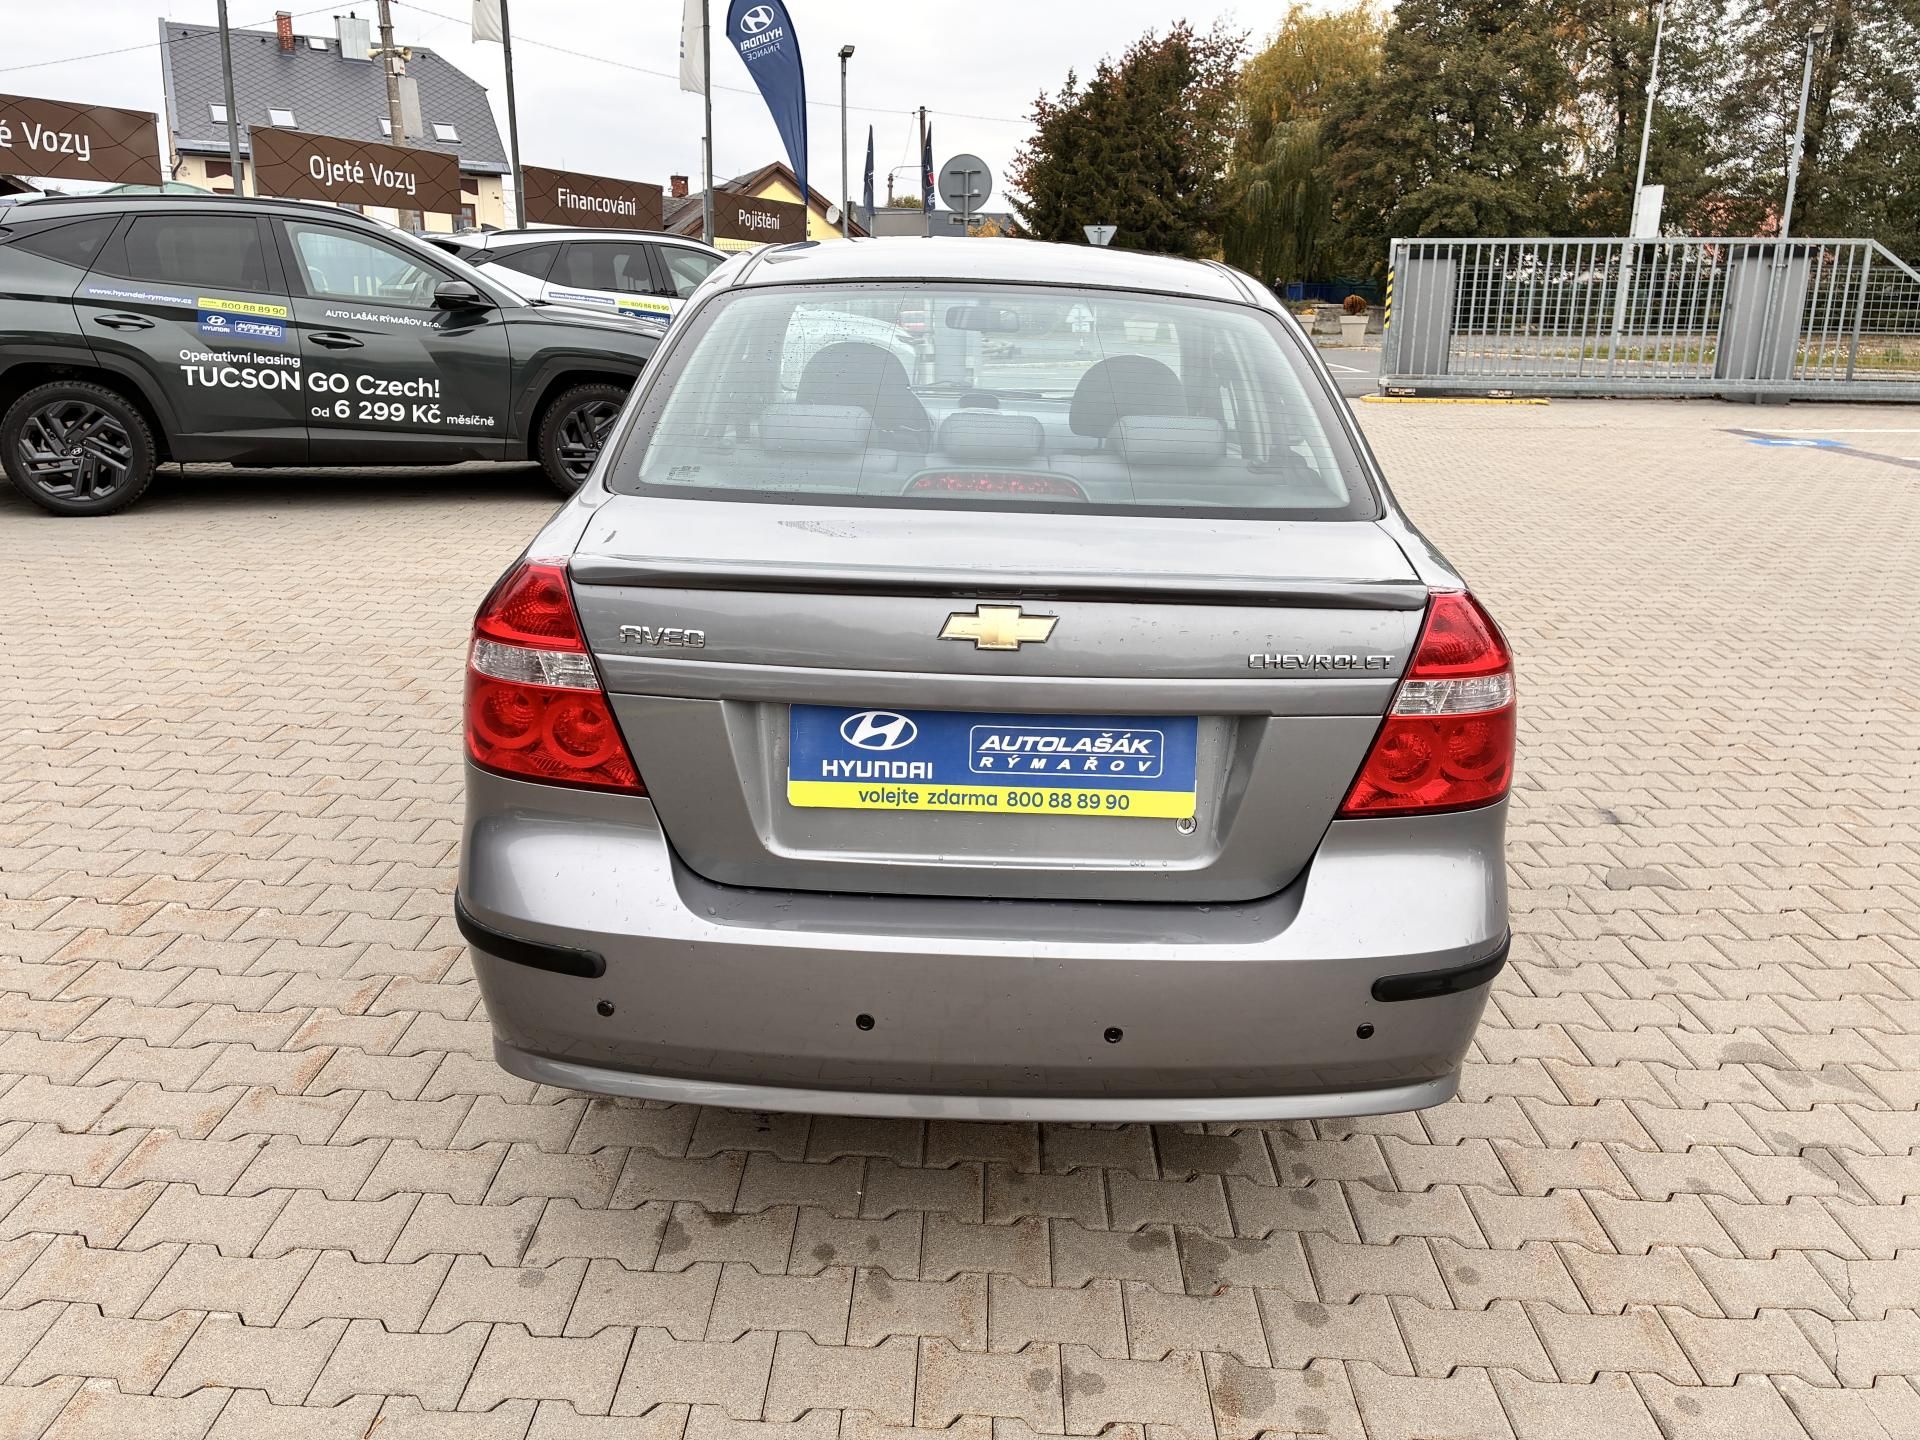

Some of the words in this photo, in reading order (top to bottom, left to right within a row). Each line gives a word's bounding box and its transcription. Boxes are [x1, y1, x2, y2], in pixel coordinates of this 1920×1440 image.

[21, 121, 91, 162] Vozy
[309, 155, 364, 186] Ojeté
[370, 162, 416, 195] Vozy
[557, 187, 636, 216] Financování
[738, 208, 780, 231] Pojištění
[221, 302, 240, 310] 800
[243, 304, 256, 312] 88
[257, 306, 270, 314] 89
[325, 309, 350, 319] AUTO
[350, 311, 379, 322] LAŠÁK
[379, 313, 422, 327] RÝMAŘOV
[202, 325, 230, 333] HYUNDAI
[179, 349, 251, 363] Operativní
[254, 353, 301, 368] leasing
[180, 365, 301, 391] TUCSON
[308, 372, 349, 393] GO
[356, 375, 440, 398] Czech!
[334, 400, 350, 418] 6
[358, 402, 405, 421] 299
[412, 403, 441, 424] Kč
[446, 415, 495, 426] měsíčně
[620, 625, 705, 648] AVEO
[1248, 653, 1395, 671] CHEVROLET
[978, 732, 1153, 754] AUTOLAŠÁK
[822, 759, 933, 780] HYUNDAI
[858, 788, 919, 807] volejte
[927, 789, 997, 807] zdarma
[1006, 791, 1044, 808] 800
[1048, 792, 1073, 809] 88
[1076, 793, 1101, 810] 89
[1105, 794, 1130, 811] 90
